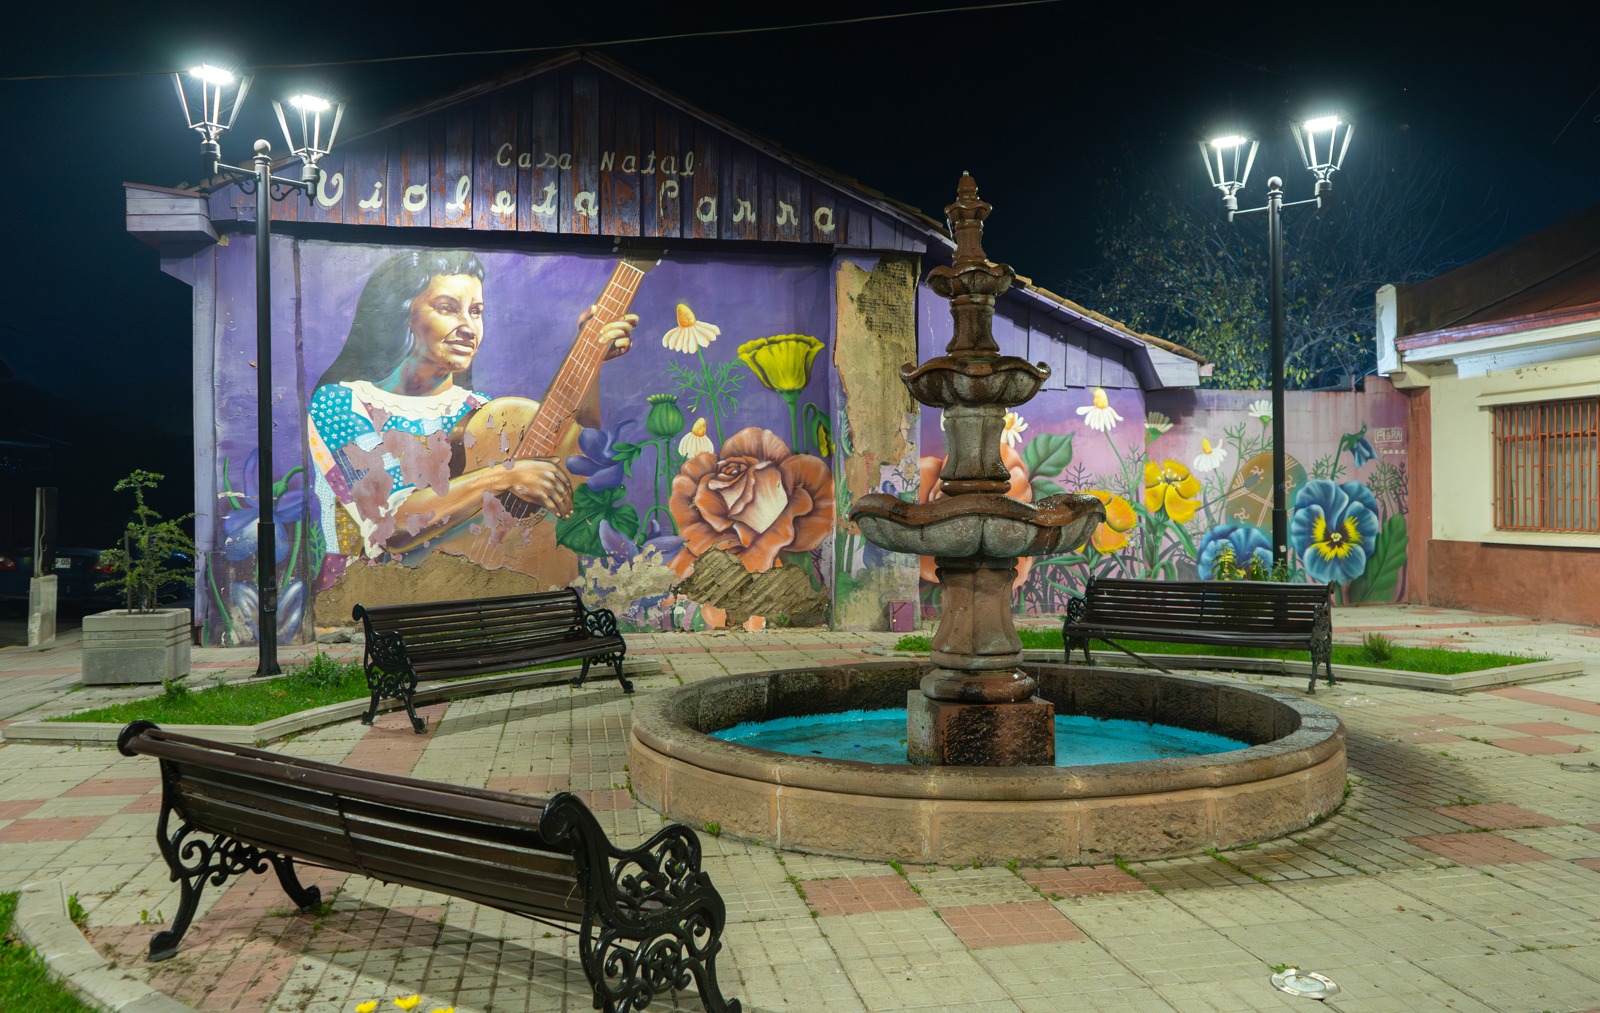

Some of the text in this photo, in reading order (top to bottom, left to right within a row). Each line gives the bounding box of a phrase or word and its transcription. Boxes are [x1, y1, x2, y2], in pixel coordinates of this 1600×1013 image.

[496, 142, 695, 176] Casa Natal
[658, 179, 836, 233] Parra
